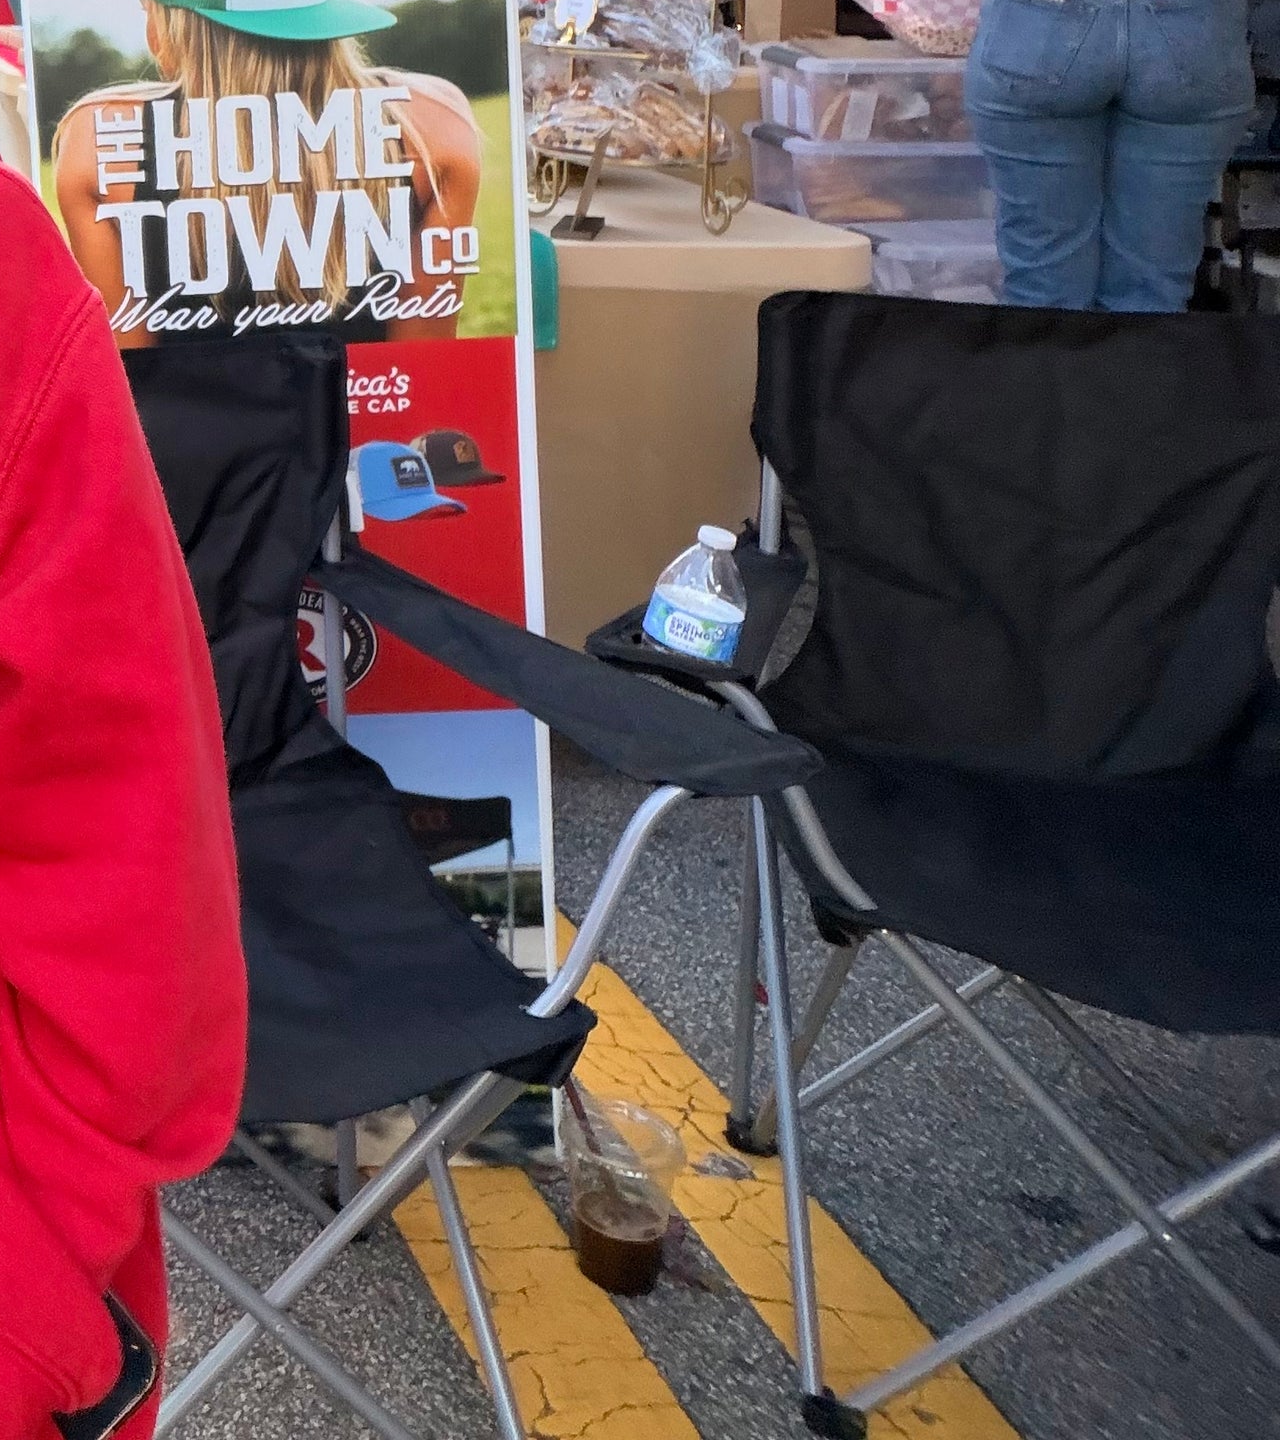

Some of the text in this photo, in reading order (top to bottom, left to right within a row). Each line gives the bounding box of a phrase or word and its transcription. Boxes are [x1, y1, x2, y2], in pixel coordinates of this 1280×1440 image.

[94, 86, 415, 195] THE HOME
[94, 185, 481, 299] TOWN CO
[109, 274, 464, 336] Wear your Roots
[368, 398, 411, 413] CAP
